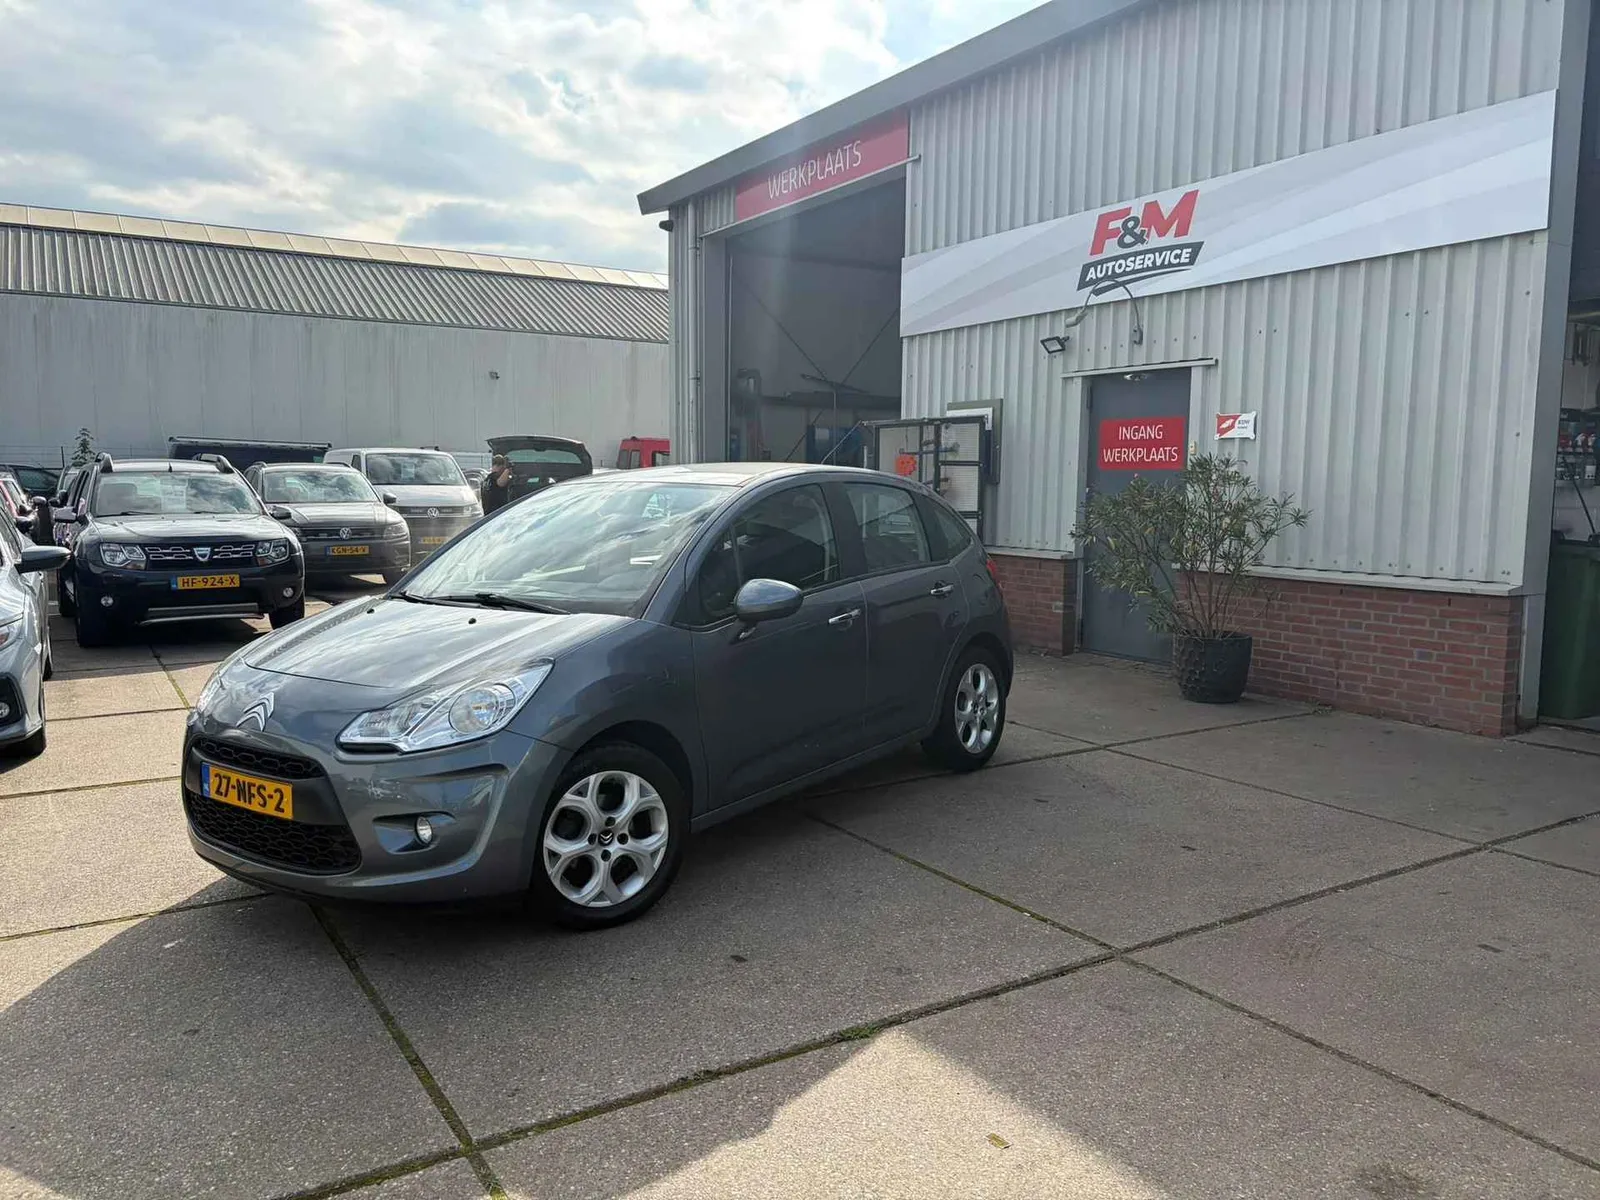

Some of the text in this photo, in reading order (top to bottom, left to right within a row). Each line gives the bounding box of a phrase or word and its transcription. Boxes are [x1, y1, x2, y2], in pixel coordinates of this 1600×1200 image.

[767, 140, 862, 200] WERKPLAATS
[1089, 189, 1200, 256] F&M
[1085, 247, 1192, 282] AUTOSERVICE
[1118, 424, 1164, 441] INGANG
[1103, 446, 1179, 463] WERKPLAATS
[181, 575, 237, 588] HF-924-X
[213, 771, 286, 814] 27-NFS-2
